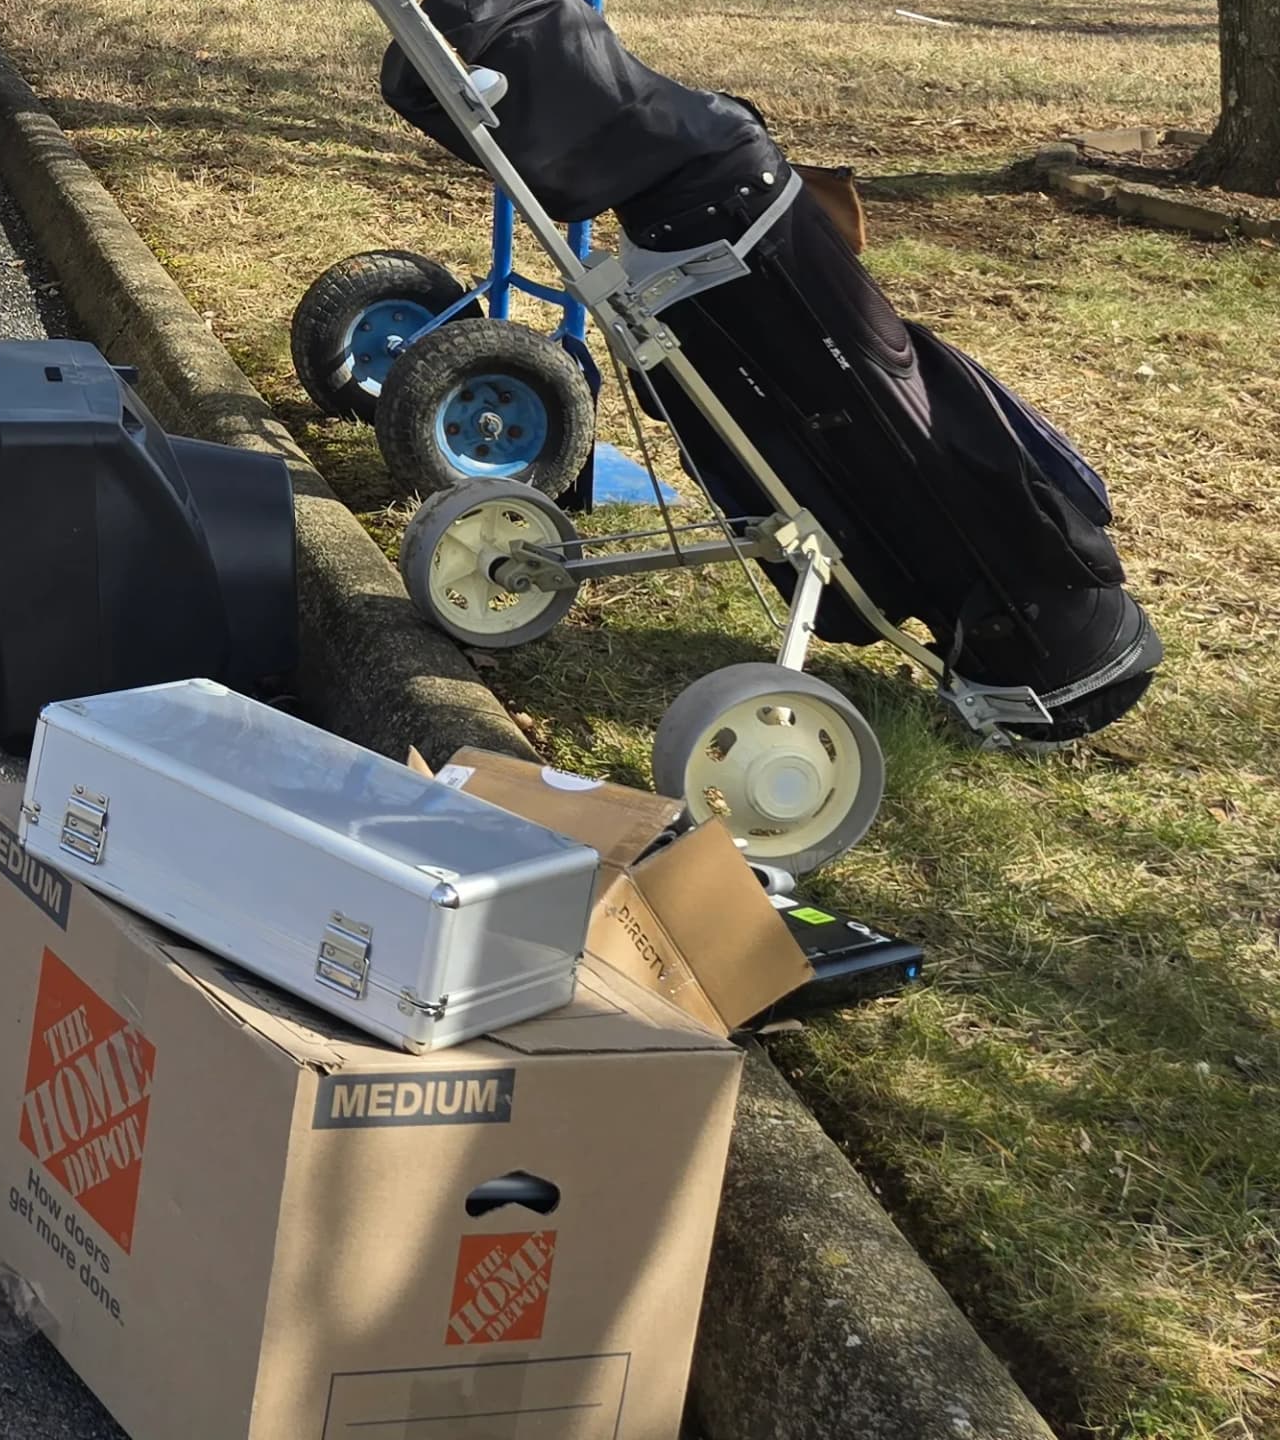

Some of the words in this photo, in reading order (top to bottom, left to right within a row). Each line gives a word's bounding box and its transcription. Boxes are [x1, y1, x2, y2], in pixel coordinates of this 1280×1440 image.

[617, 904, 668, 980] DIRECTV
[43, 1004, 93, 1066] THE
[23, 1025, 152, 1161] HOME
[331, 1079, 499, 1119] MEDIUM
[61, 1113, 143, 1198] DEPOT
[9, 1186, 35, 1224] get
[36, 1215, 77, 1270] more
[28, 1167, 62, 1221] How
[64, 1213, 111, 1274] doers
[449, 1231, 556, 1344] HOME
[464, 1244, 508, 1288] THE
[485, 1270, 549, 1340] DEPOT
